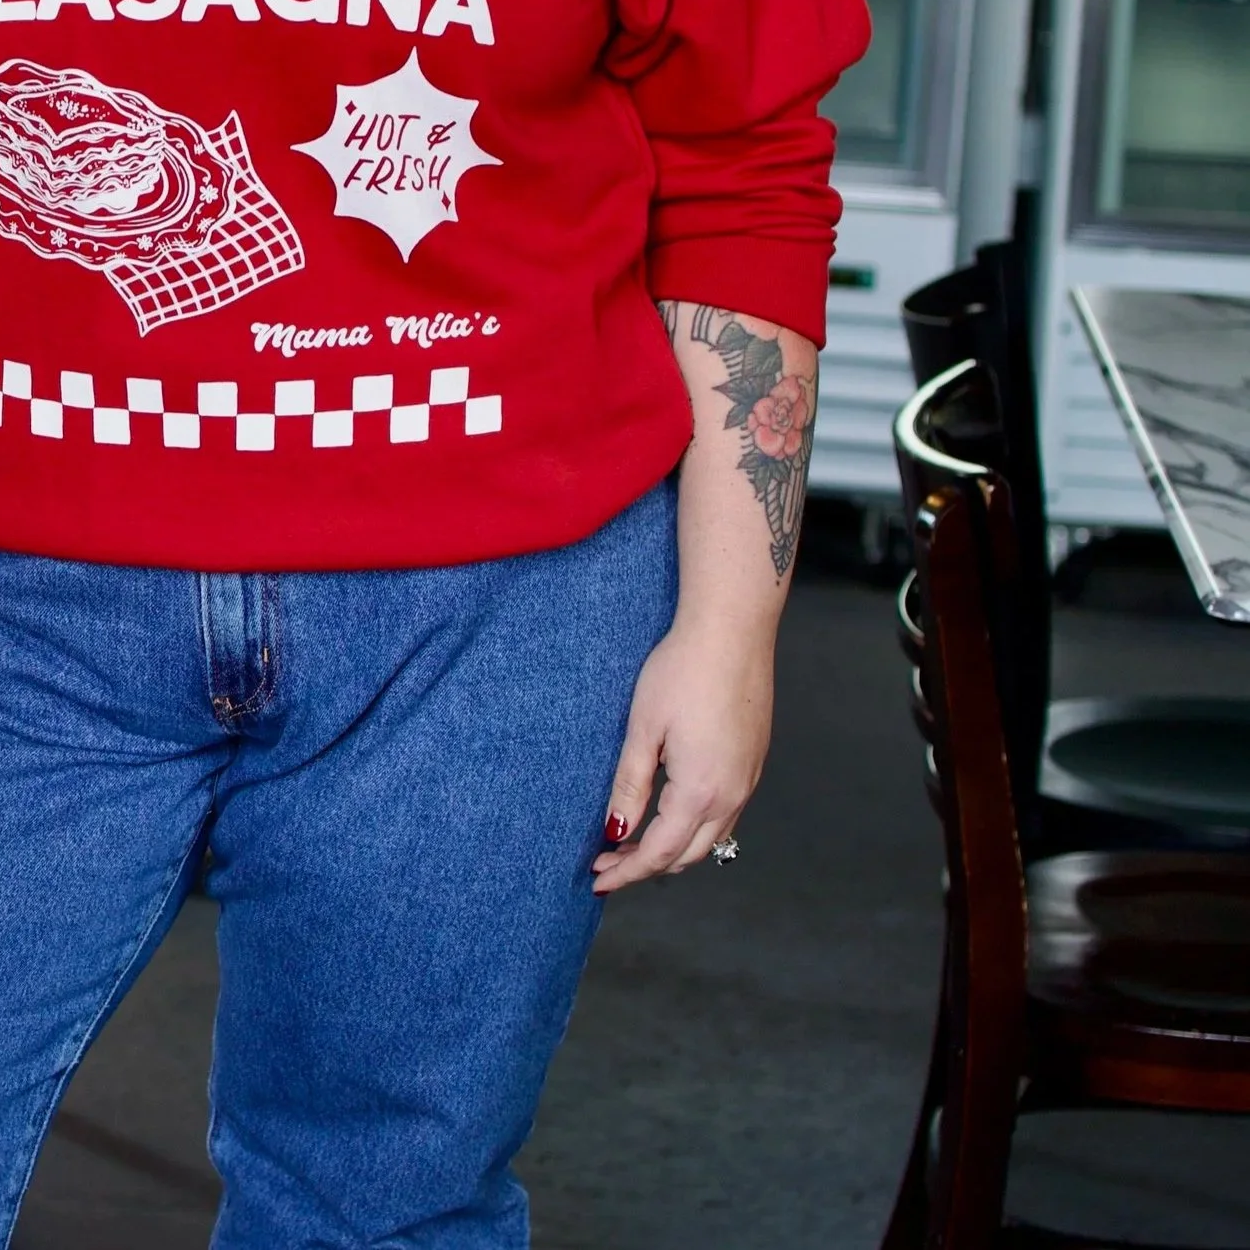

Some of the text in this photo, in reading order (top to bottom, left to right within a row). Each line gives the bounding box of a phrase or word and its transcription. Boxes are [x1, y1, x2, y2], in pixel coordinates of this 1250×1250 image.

[344, 113, 457, 151] HOT &
[343, 154, 452, 195] FRESH
[250, 311, 501, 358] Mama Mila's
